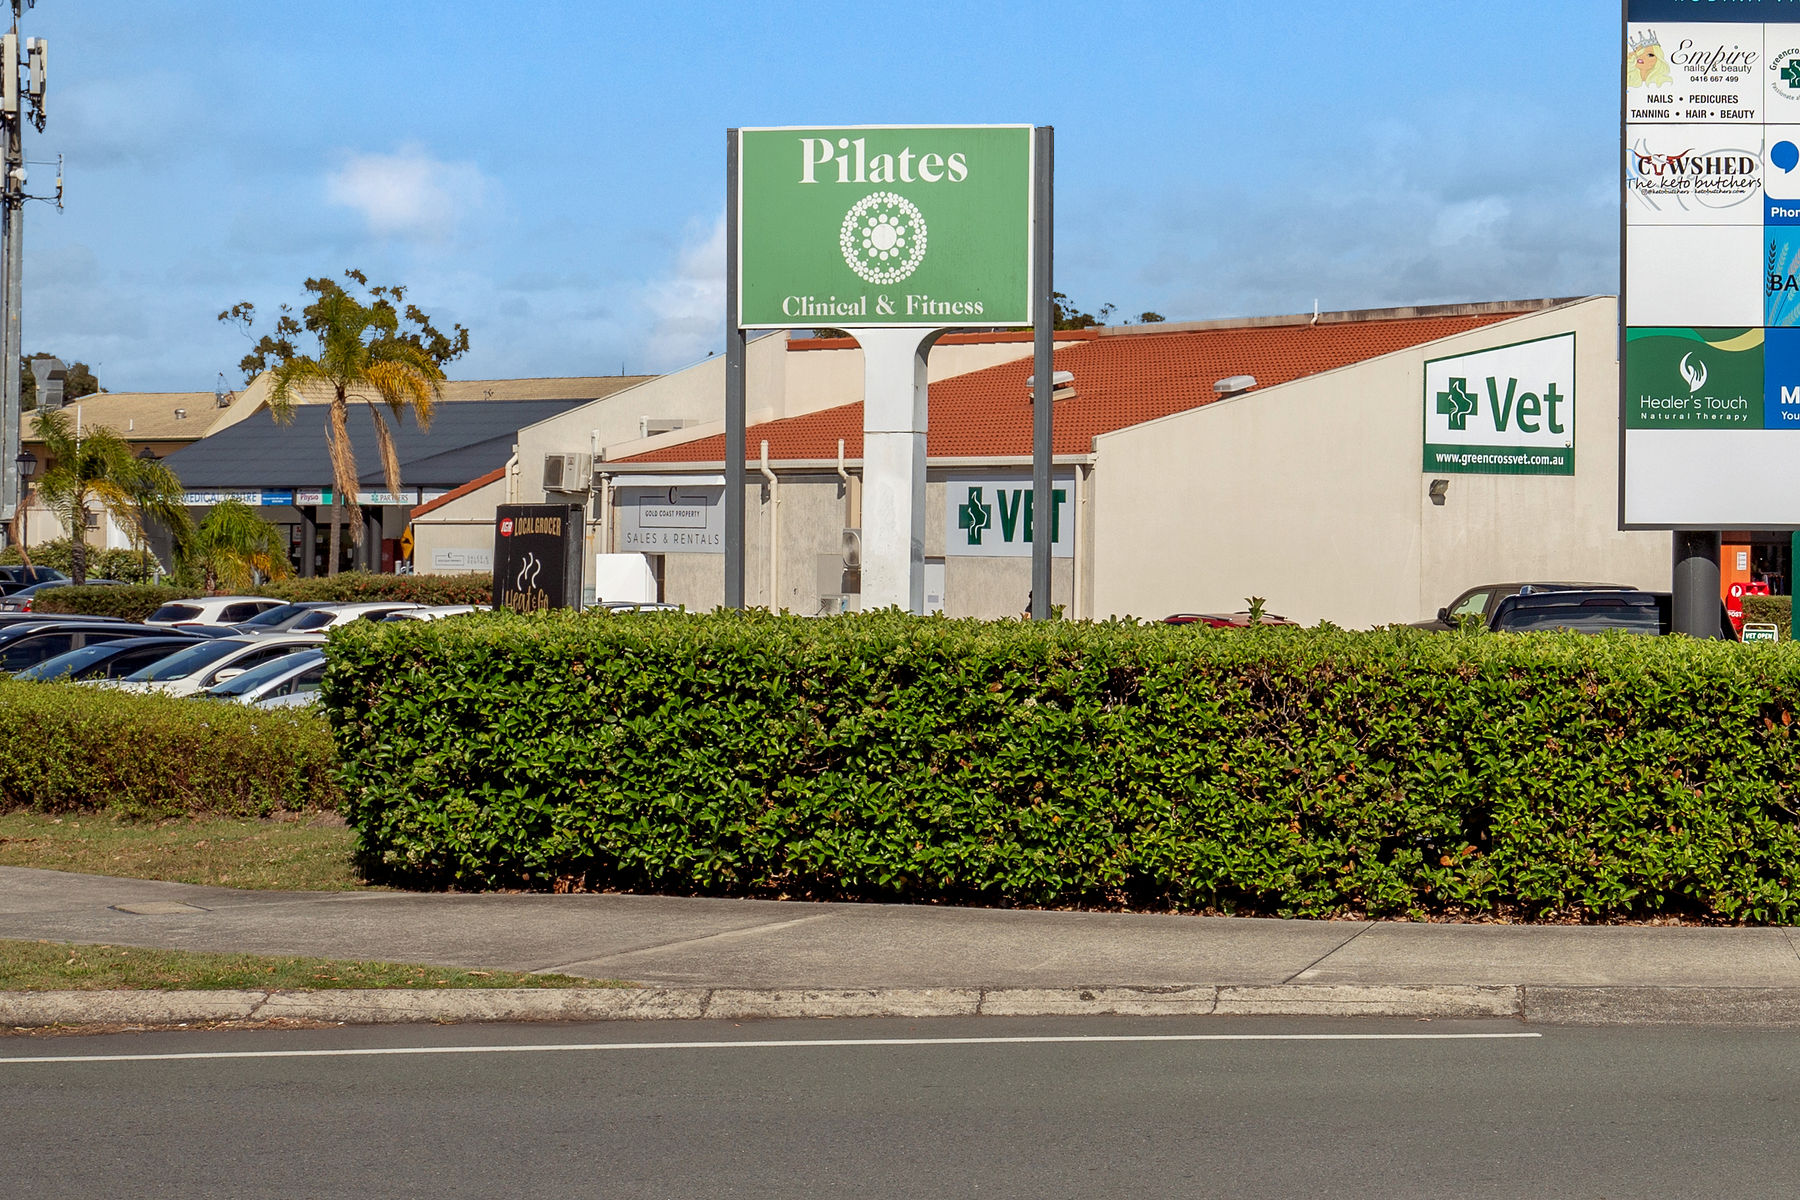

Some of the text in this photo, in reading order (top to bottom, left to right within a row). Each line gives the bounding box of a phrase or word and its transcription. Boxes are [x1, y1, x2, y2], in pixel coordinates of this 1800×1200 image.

[1671, 39, 1760, 75] Empire
[1684, 64, 1705, 72] nails
[1721, 64, 1752, 74] beauty
[1647, 95, 1739, 104] NAILS PEDICURES
[1631, 109, 1755, 119] TANNING HAIR BEAUTY
[798, 137, 969, 184] Pilates
[1627, 175, 1762, 190] The keto butchers
[782, 294, 984, 317] Clinical & Fitness
[1485, 376, 1565, 434] Vet
[1640, 395, 1748, 410] Healer's Touch
[1696, 413, 1748, 422] Therapy
[1435, 451, 1565, 466] www.greencrossvet.com.au
[659, 510, 675, 518] COAST
[675, 510, 700, 518] PROPERTY
[514, 517, 534, 537] LOCAL
[534, 517, 561, 537] GROCER
[627, 532, 720, 545] SALES & RENTALS
[505, 585, 532, 612] Heat
